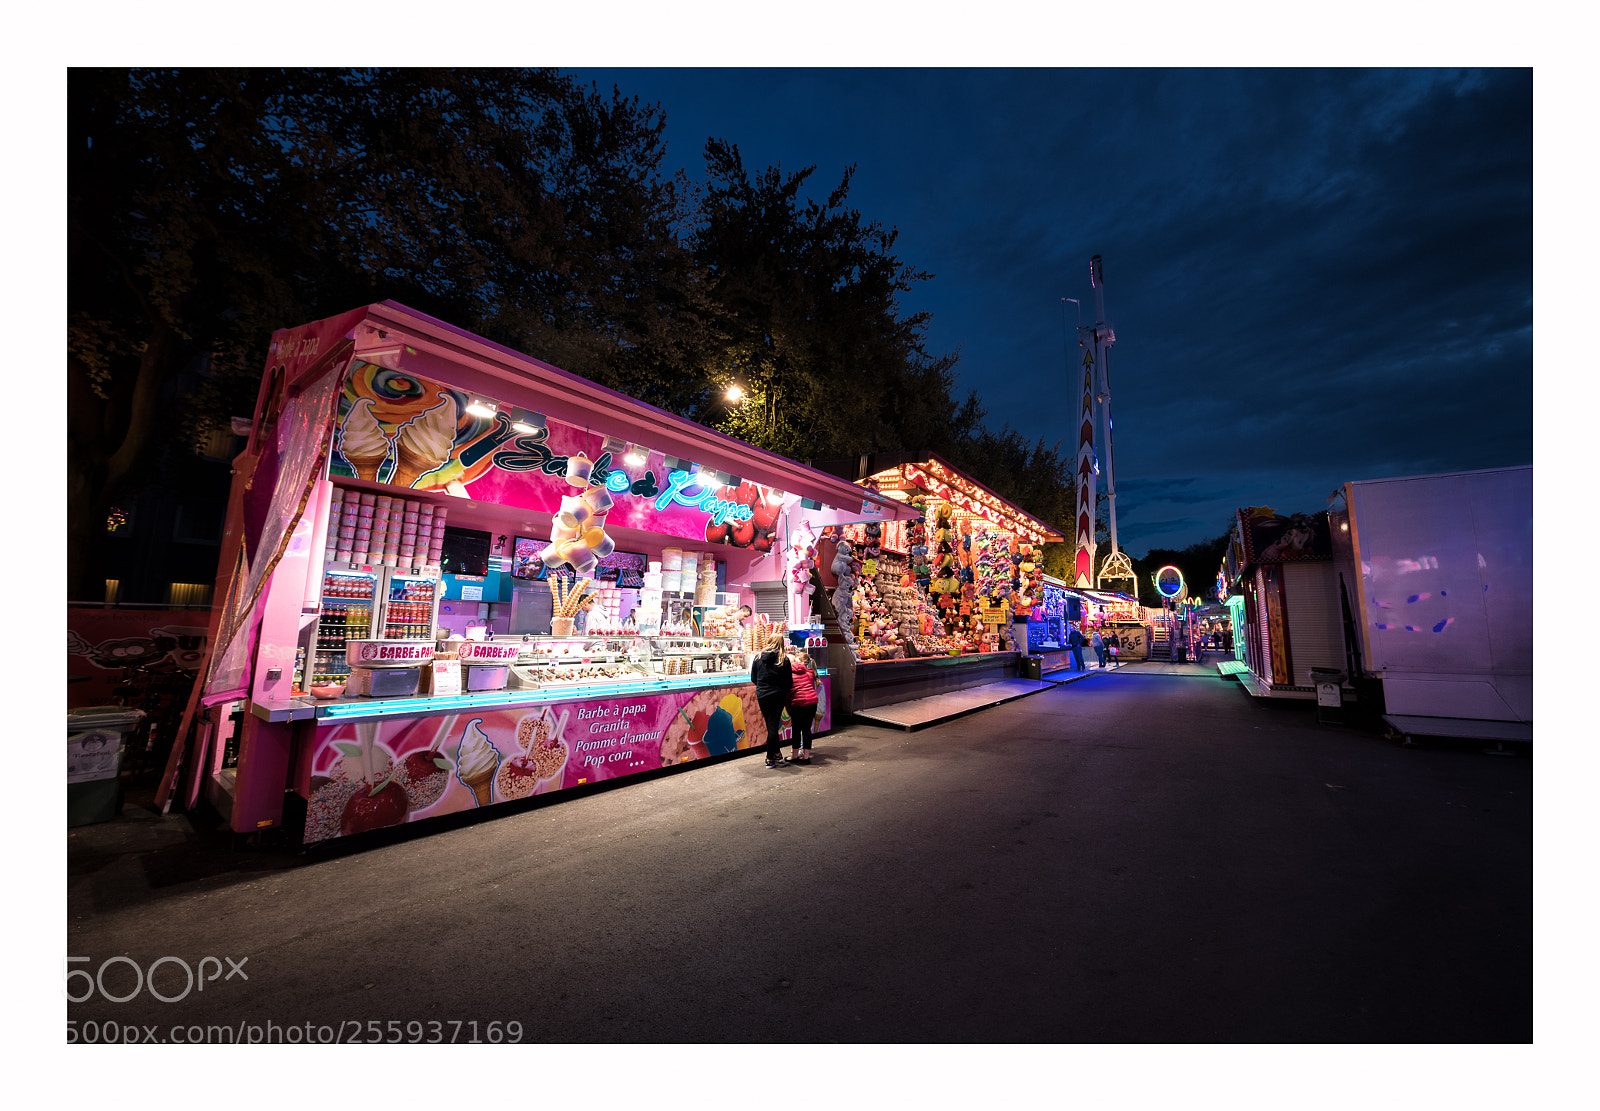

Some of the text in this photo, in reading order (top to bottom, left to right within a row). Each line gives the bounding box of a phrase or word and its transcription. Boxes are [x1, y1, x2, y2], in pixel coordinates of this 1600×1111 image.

[654, 469, 755, 526] Papa
[380, 646, 415, 659] BARBE
[577, 703, 647, 720] Barbe à papa
[589, 719, 630, 734] Granita
[575, 730, 661, 752] Pomme d'amour
[583, 750, 632, 768] Pop corn
